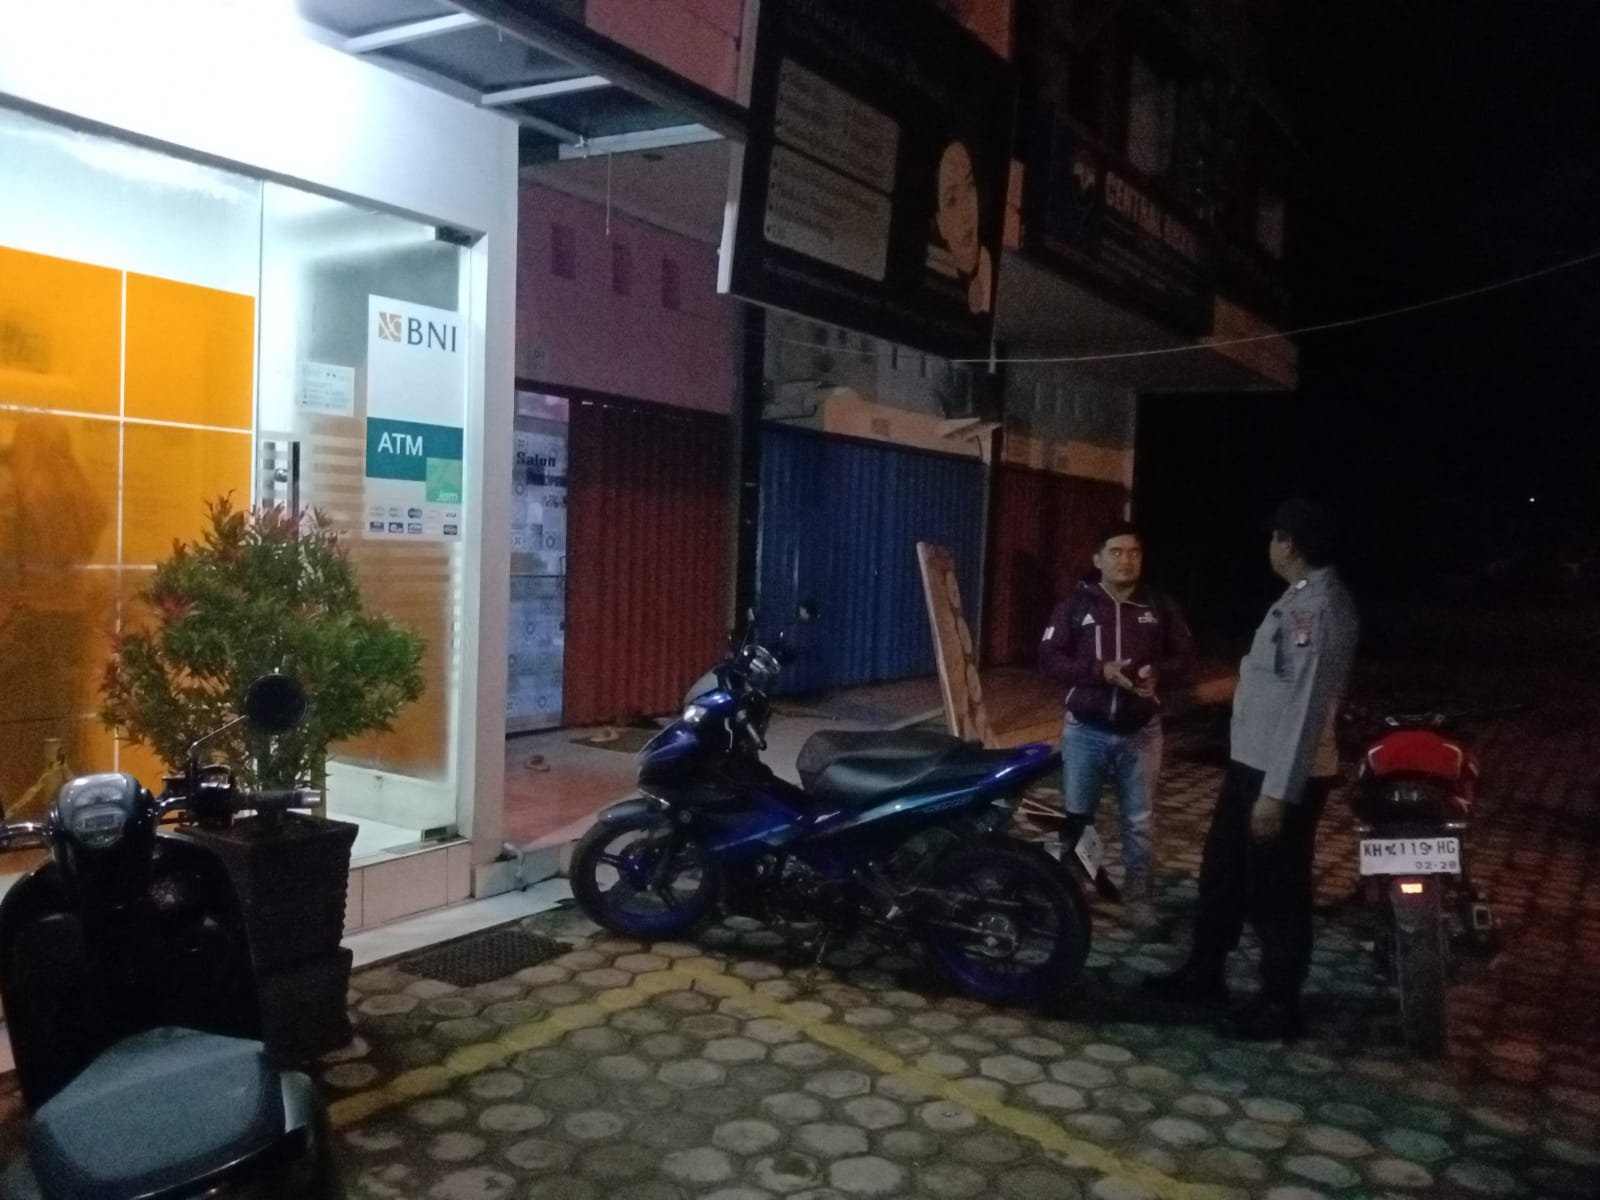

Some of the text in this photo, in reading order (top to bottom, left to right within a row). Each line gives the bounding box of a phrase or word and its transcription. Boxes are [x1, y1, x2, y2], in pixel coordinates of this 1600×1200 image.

[407, 316, 457, 353] BNI
[377, 431, 424, 457] ATM
[516, 450, 556, 467] Salon
[1363, 842, 1382, 857] KH
[1436, 839, 1456, 854] HG
